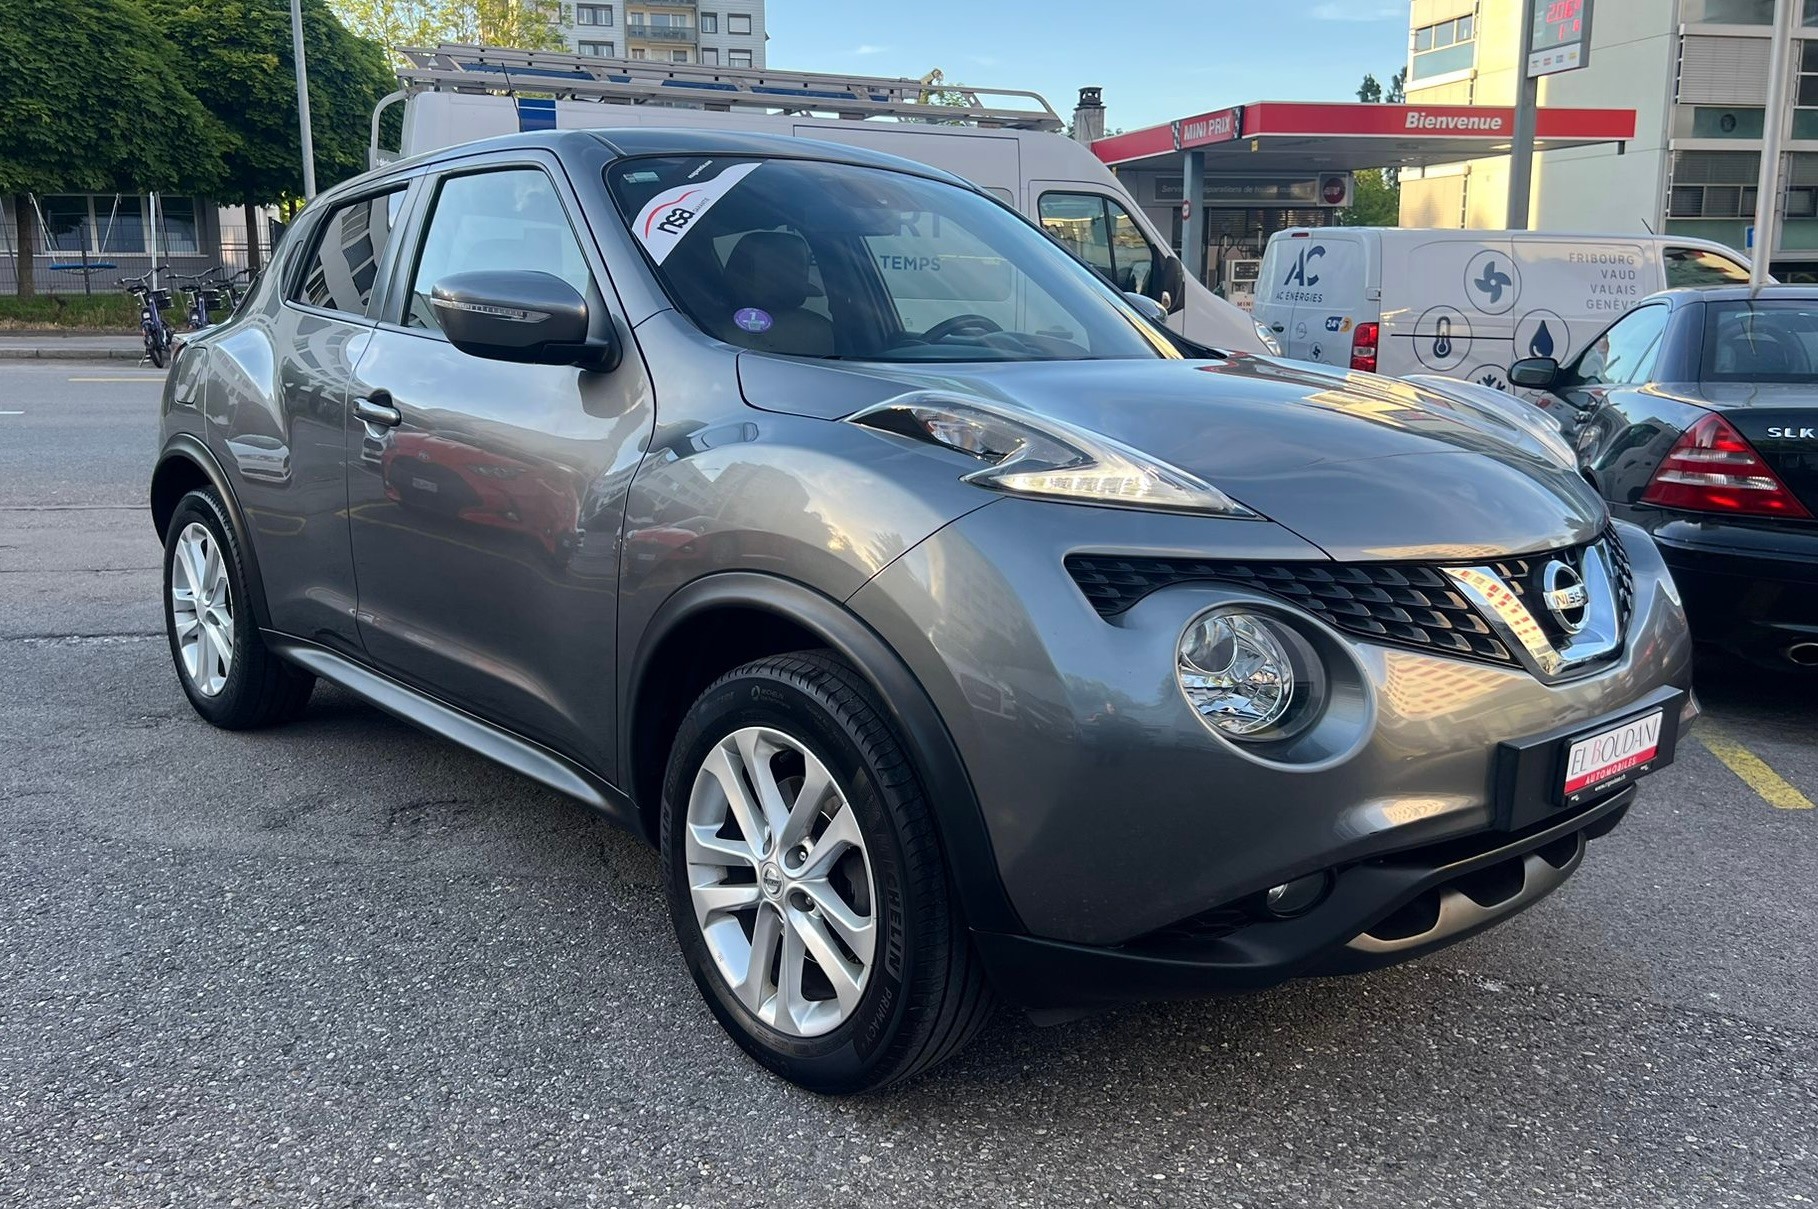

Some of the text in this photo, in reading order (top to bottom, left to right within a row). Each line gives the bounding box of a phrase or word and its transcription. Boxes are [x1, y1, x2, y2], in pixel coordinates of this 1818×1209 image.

[1183, 115, 1231, 141] MINI PRIX
[1404, 112, 1502, 130] Bienvenue
[657, 208, 695, 235] nsa
[879, 255, 941, 271] TEMPS
[1283, 245, 1326, 287] AC
[1569, 252, 1635, 265] FRIBOURG
[1600, 269, 1636, 280] VAUD
[1590, 284, 1636, 295] VALAIS
[1767, 427, 1815, 439] SLK
[1571, 747, 1587, 776] EL
[1584, 757, 1637, 785] AUTOMOBILES
[863, 986, 893, 1042] PRIMACY
